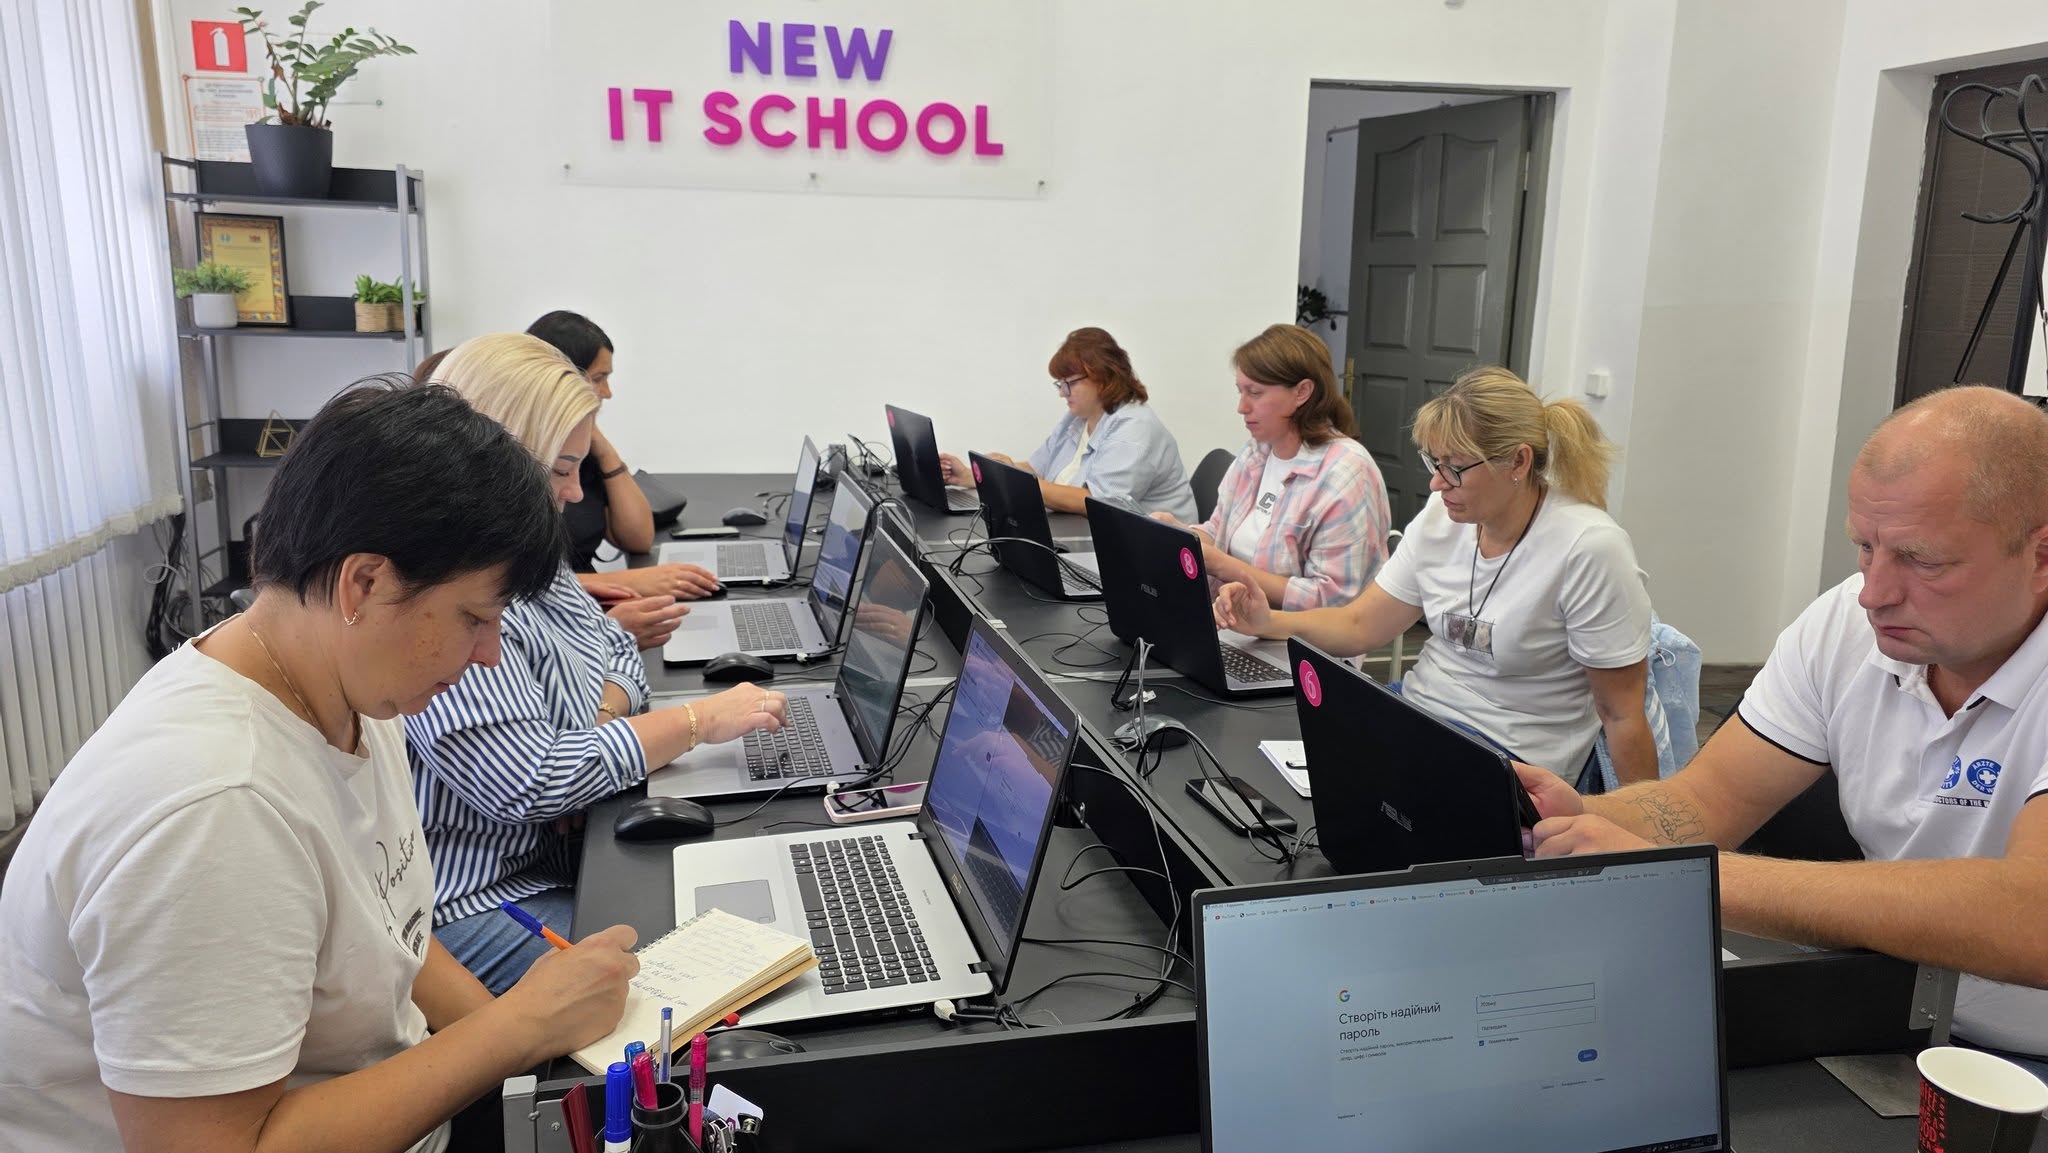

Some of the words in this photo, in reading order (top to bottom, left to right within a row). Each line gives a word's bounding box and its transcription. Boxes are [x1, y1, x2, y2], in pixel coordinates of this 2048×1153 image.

[729, 19, 893, 82] NEW
[608, 87, 673, 143] IT
[703, 91, 1003, 156] SCHOOL
[1304, 671, 1317, 700] 6
[1338, 1009, 1388, 1025] Створіть
[1390, 1002, 1441, 1018] надійний
[1339, 1028, 1381, 1041] пароль
